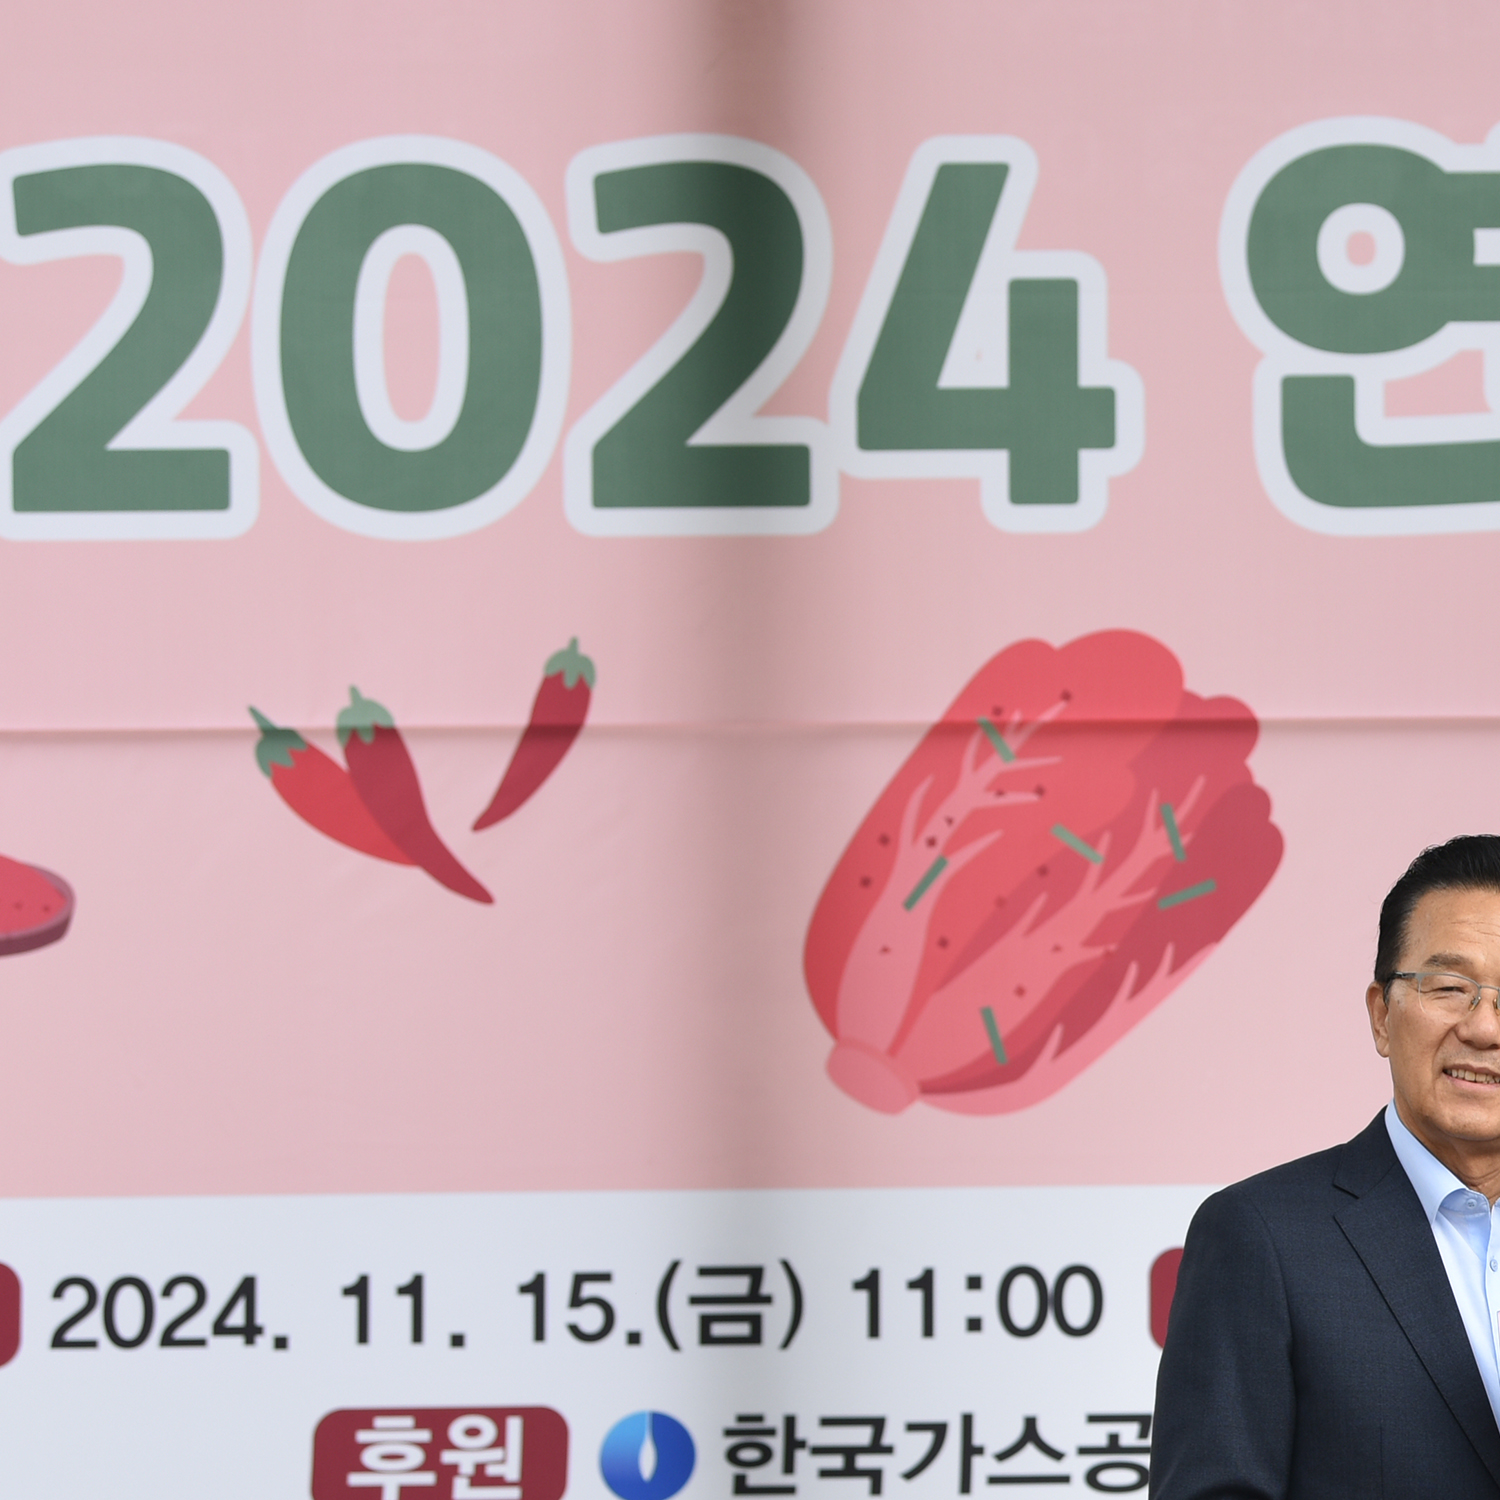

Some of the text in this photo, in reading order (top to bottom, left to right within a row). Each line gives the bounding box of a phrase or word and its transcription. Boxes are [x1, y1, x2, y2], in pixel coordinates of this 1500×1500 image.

[10, 158, 1118, 515] 2024
[50, 1258, 1105, 1352] 2024. 11. 15.(금) 11:00
[722, 1411, 1152, 1498] 한국가스공
